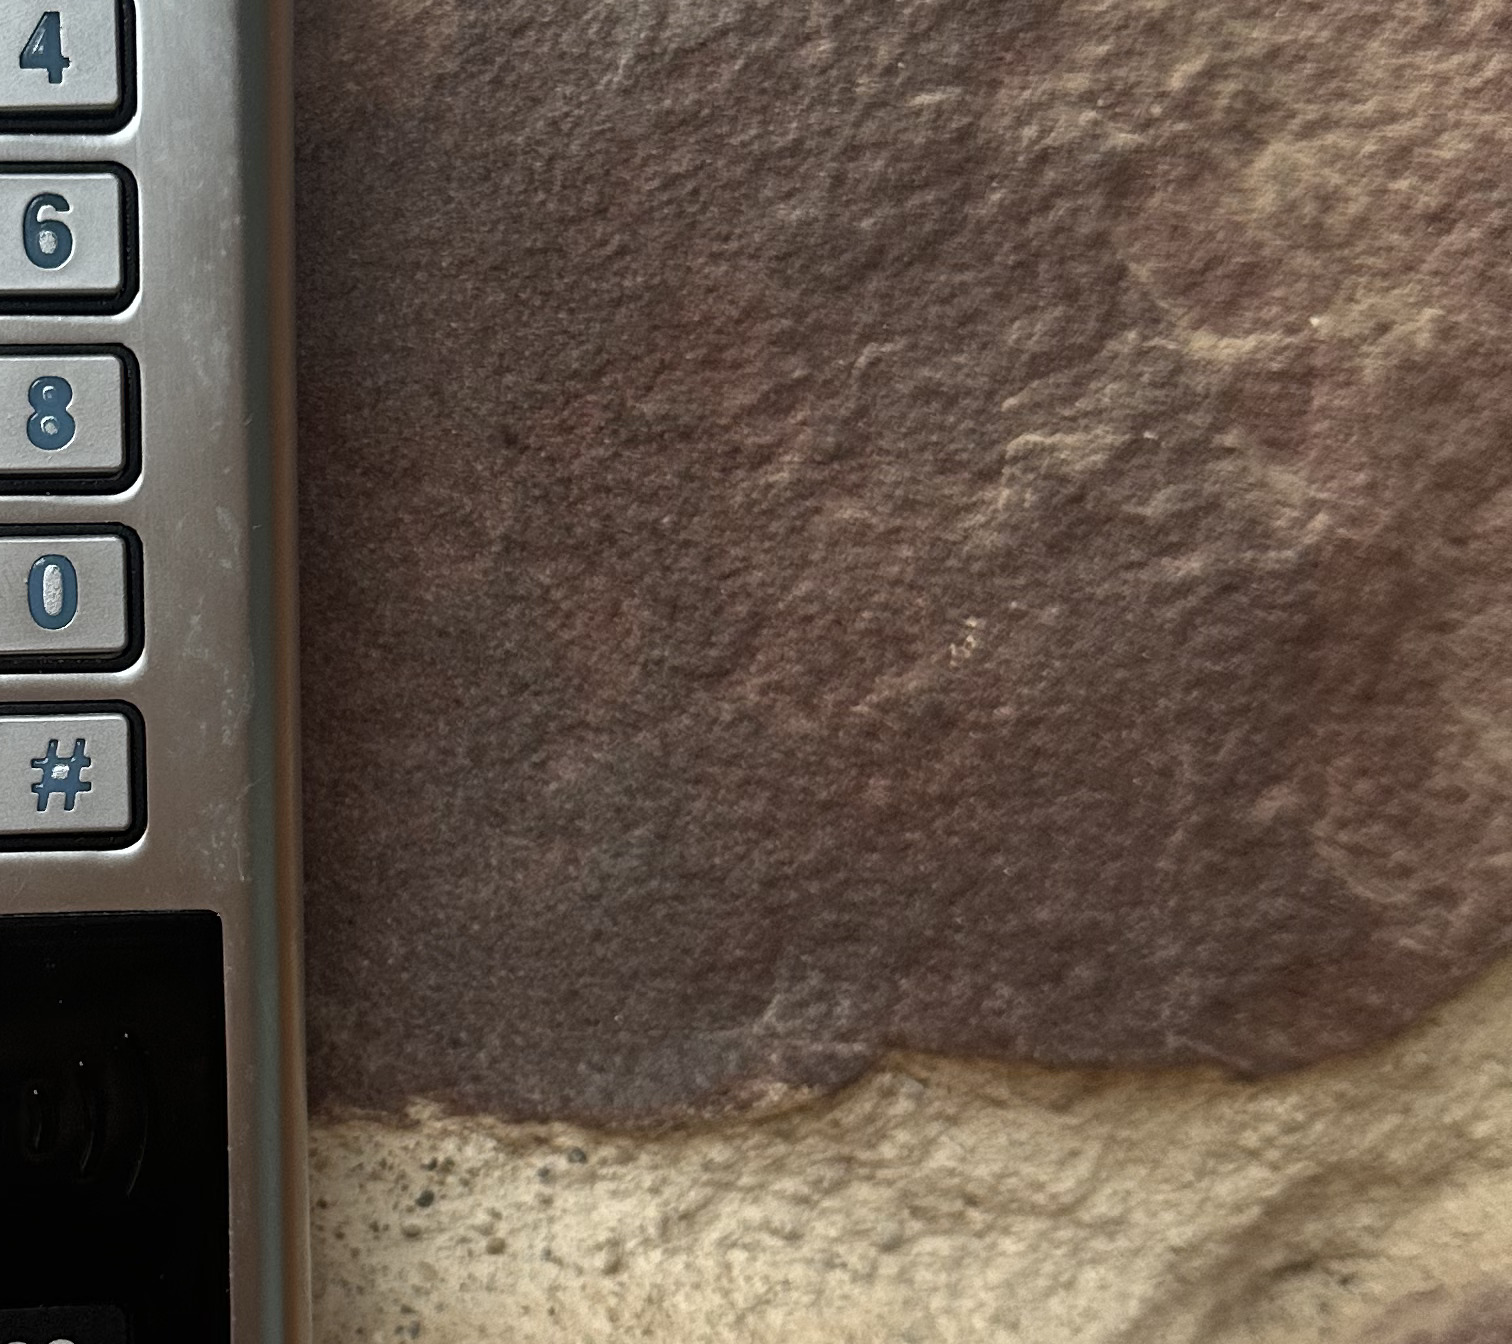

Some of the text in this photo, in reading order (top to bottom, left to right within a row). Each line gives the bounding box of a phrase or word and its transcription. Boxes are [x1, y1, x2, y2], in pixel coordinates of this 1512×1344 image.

[18, 10, 73, 85] 4
[21, 193, 75, 270] 6
[25, 375, 78, 452] 8
[27, 553, 78, 630] 0
[30, 738, 92, 812] #
